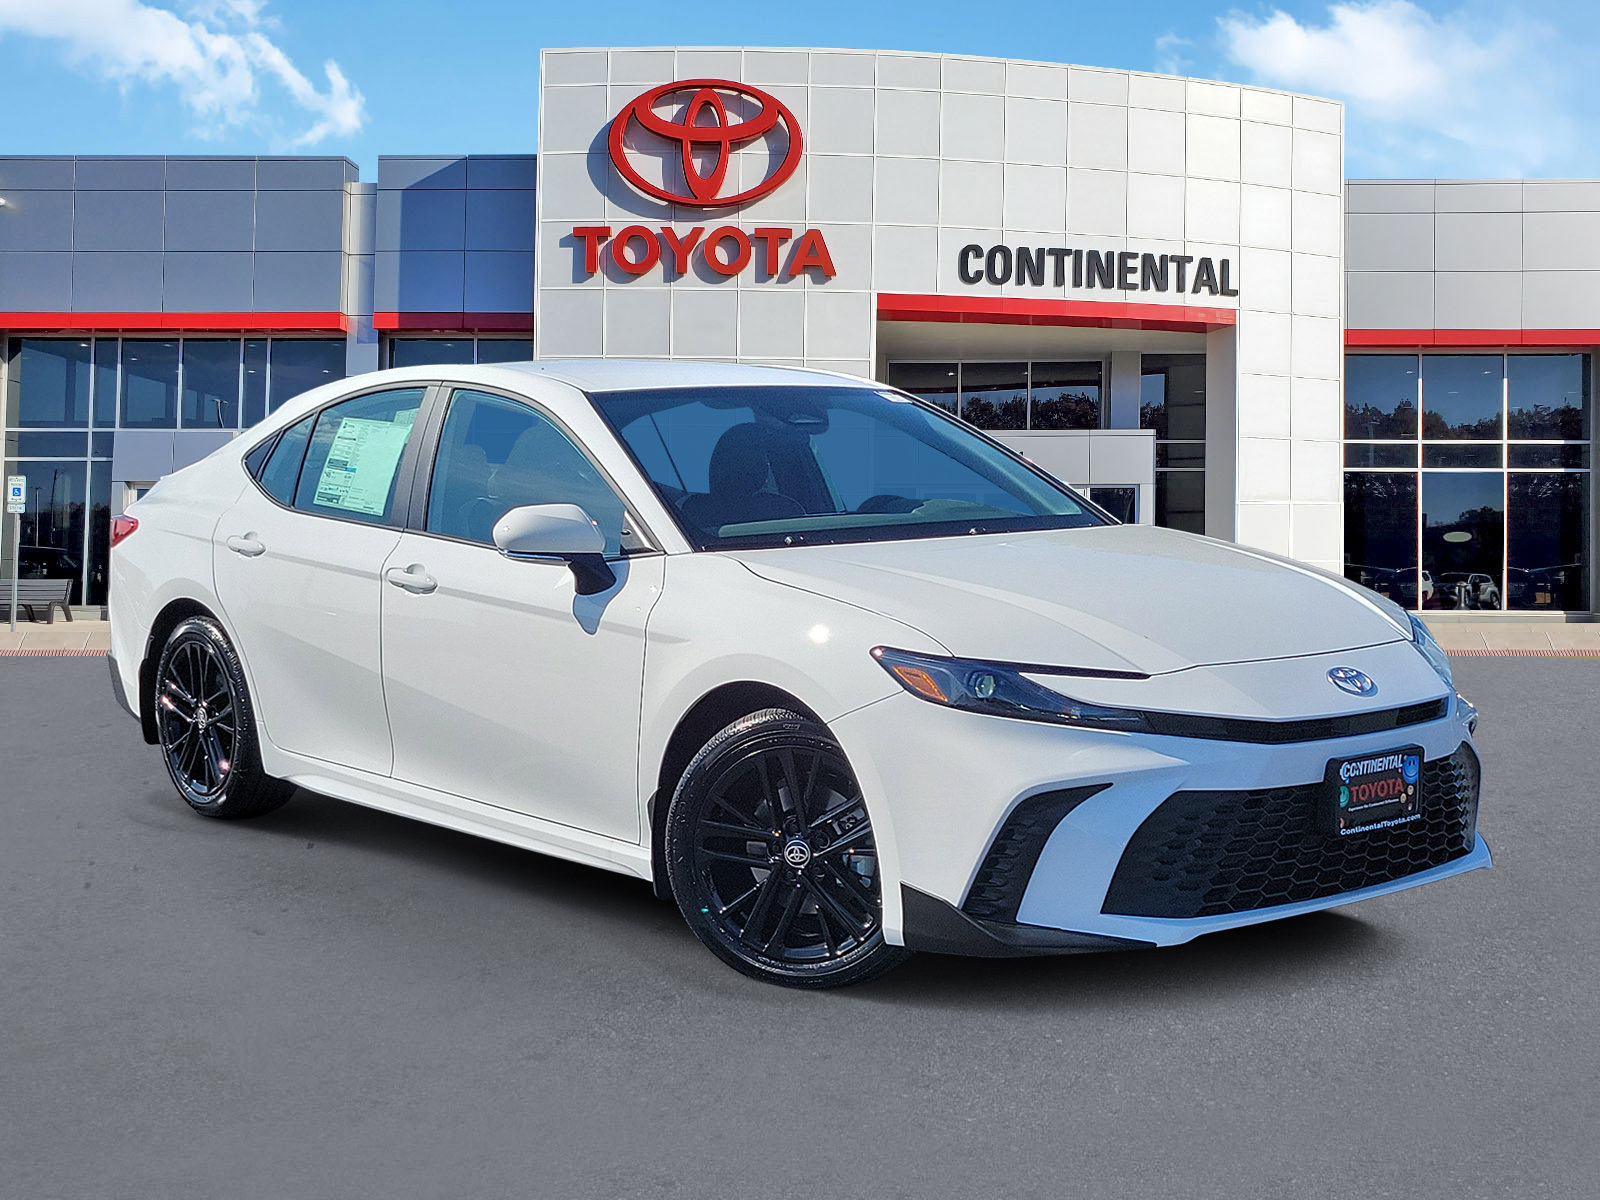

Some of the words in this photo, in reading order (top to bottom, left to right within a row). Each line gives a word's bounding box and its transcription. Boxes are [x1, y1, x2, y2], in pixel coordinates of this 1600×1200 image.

[573, 225, 836, 277] TOYOTA
[959, 244, 1238, 296] CONTINENTAL
[1340, 755, 1403, 780] CONTINENTAL
[1351, 778, 1404, 802] TOYOTA
[1340, 814, 1420, 835] ContinentalToyota.com
